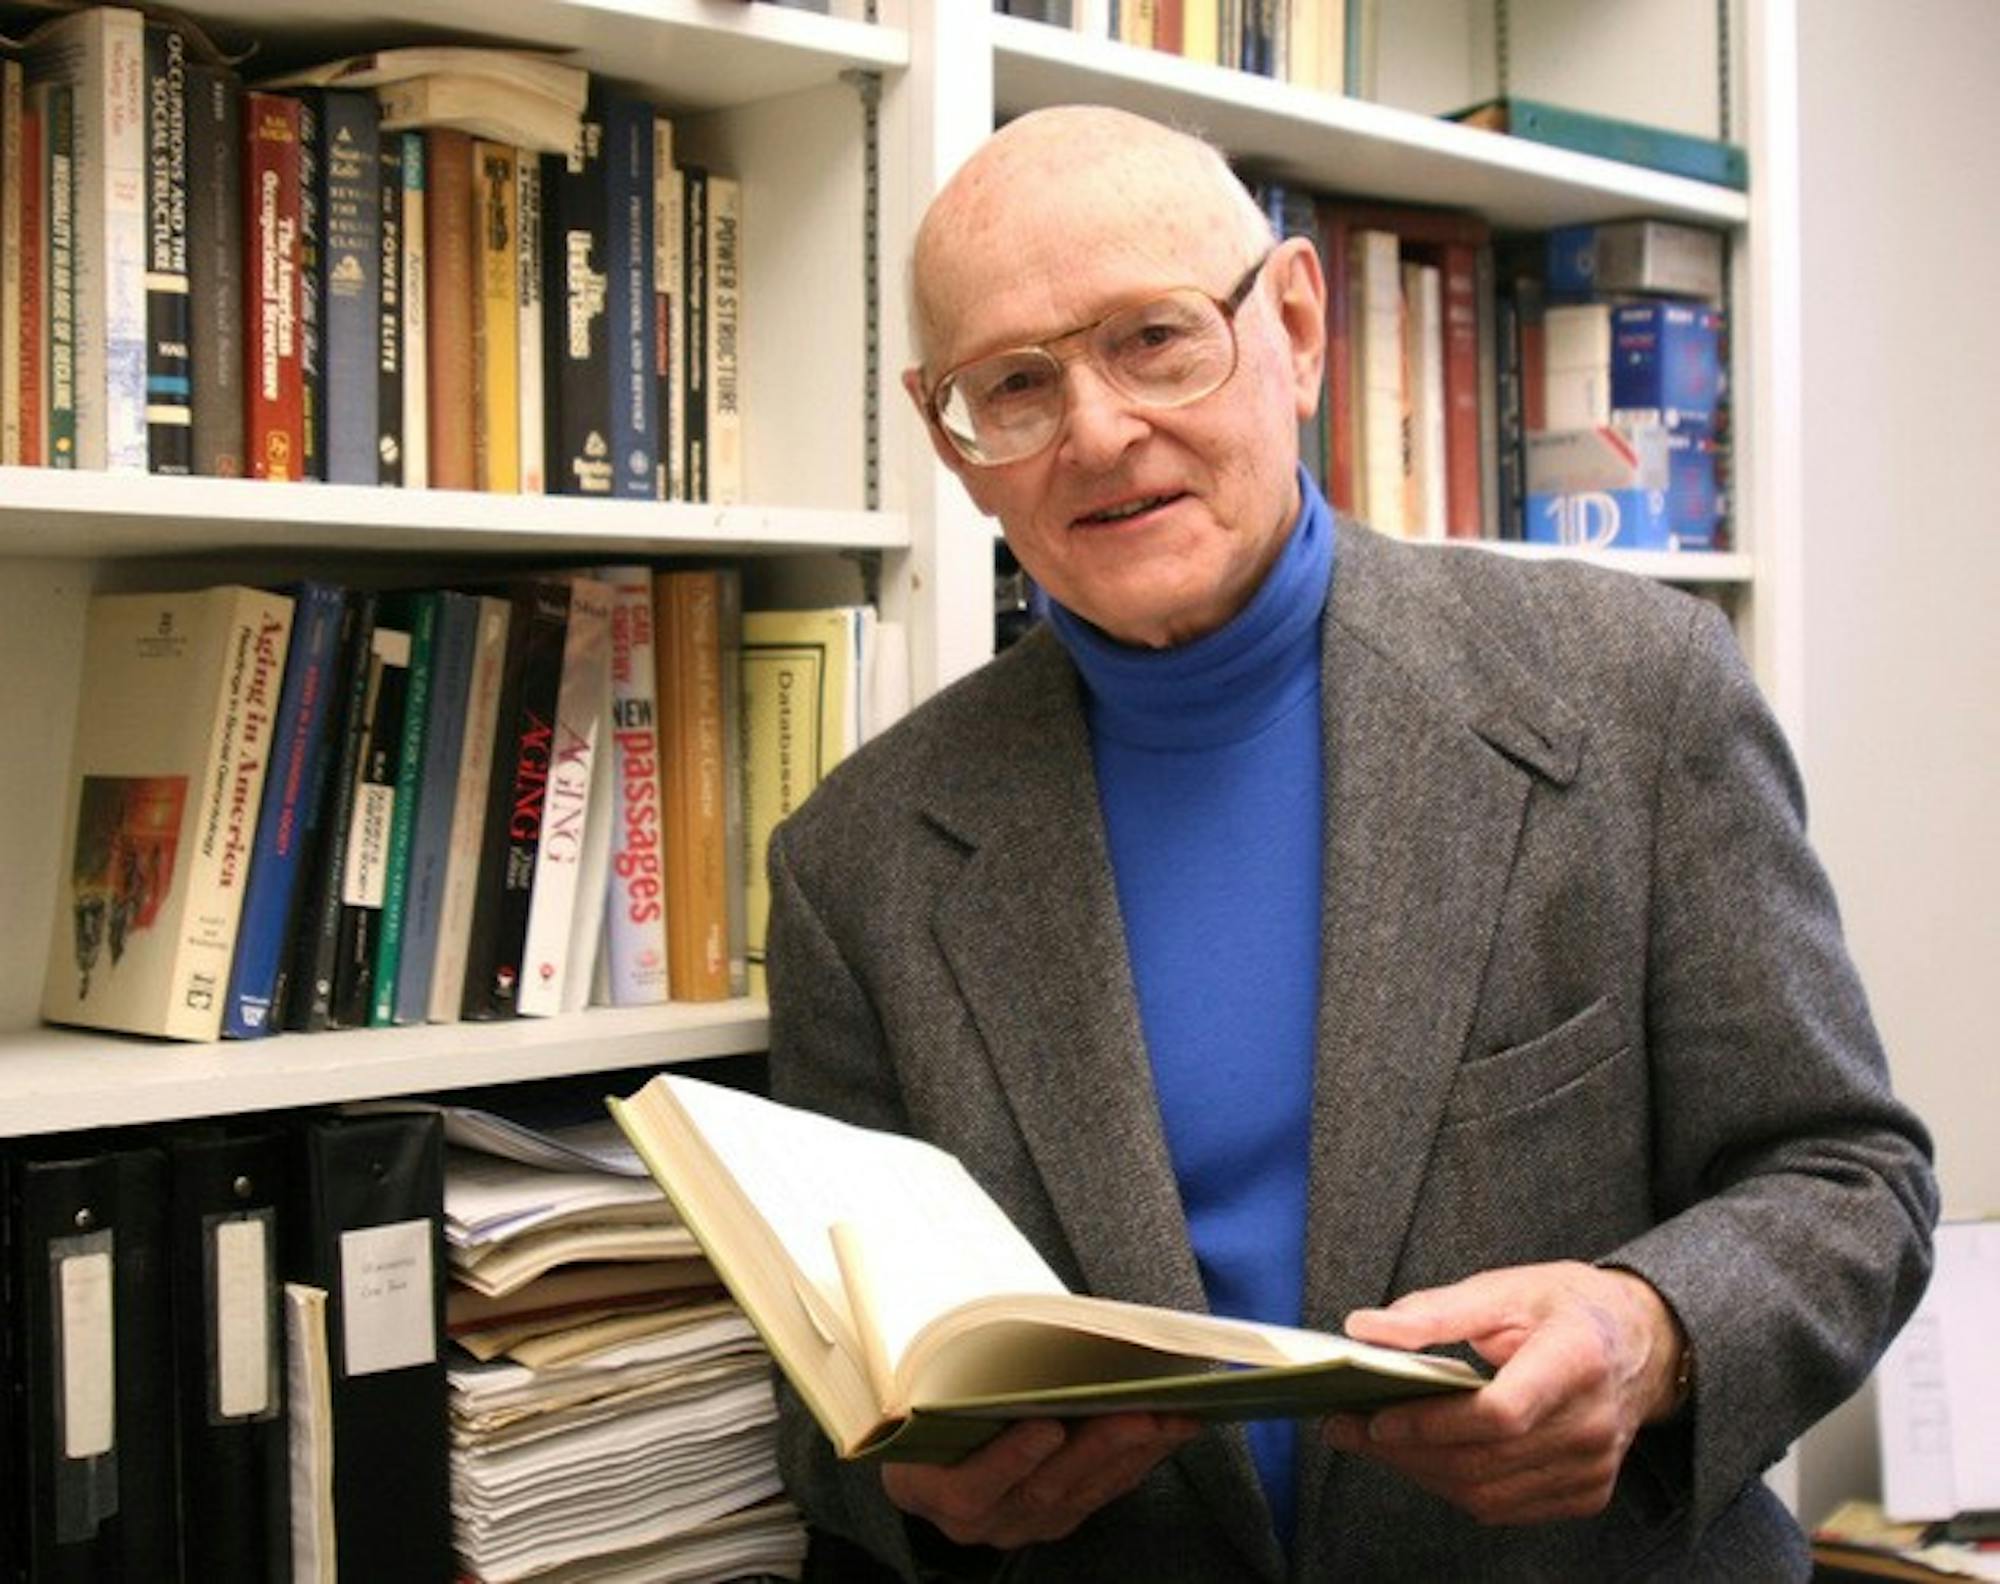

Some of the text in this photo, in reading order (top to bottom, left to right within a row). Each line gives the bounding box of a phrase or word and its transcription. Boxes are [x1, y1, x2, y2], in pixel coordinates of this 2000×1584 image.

[153, 77, 171, 271] SOCIAL STRUCTURE
[168, 33, 187, 273] OCCUPATIONS AND THE
[53, 155, 71, 248] INEQUALITY
[259, 170, 278, 401] Occupational Structure
[278, 217, 295, 356] The American
[383, 221, 397, 304] POWER
[717, 215, 737, 290] POWER
[218, 285, 231, 331] Social
[382, 314, 397, 373] ELITE
[631, 338, 645, 371] AND
[54, 343, 72, 409] DECLINE
[717, 295, 738, 416] STRUCTURE
[632, 374, 647, 433] REVOLT
[230, 626, 253, 695] Readings
[220, 610, 283, 888] Aging in America
[221, 715, 238, 762] Social
[508, 710, 553, 840] AGING
[778, 670, 795, 815] Databases
[203, 765, 230, 858] Gerontology
[546, 720, 591, 865] AGING
[612, 731, 659, 923] passages
